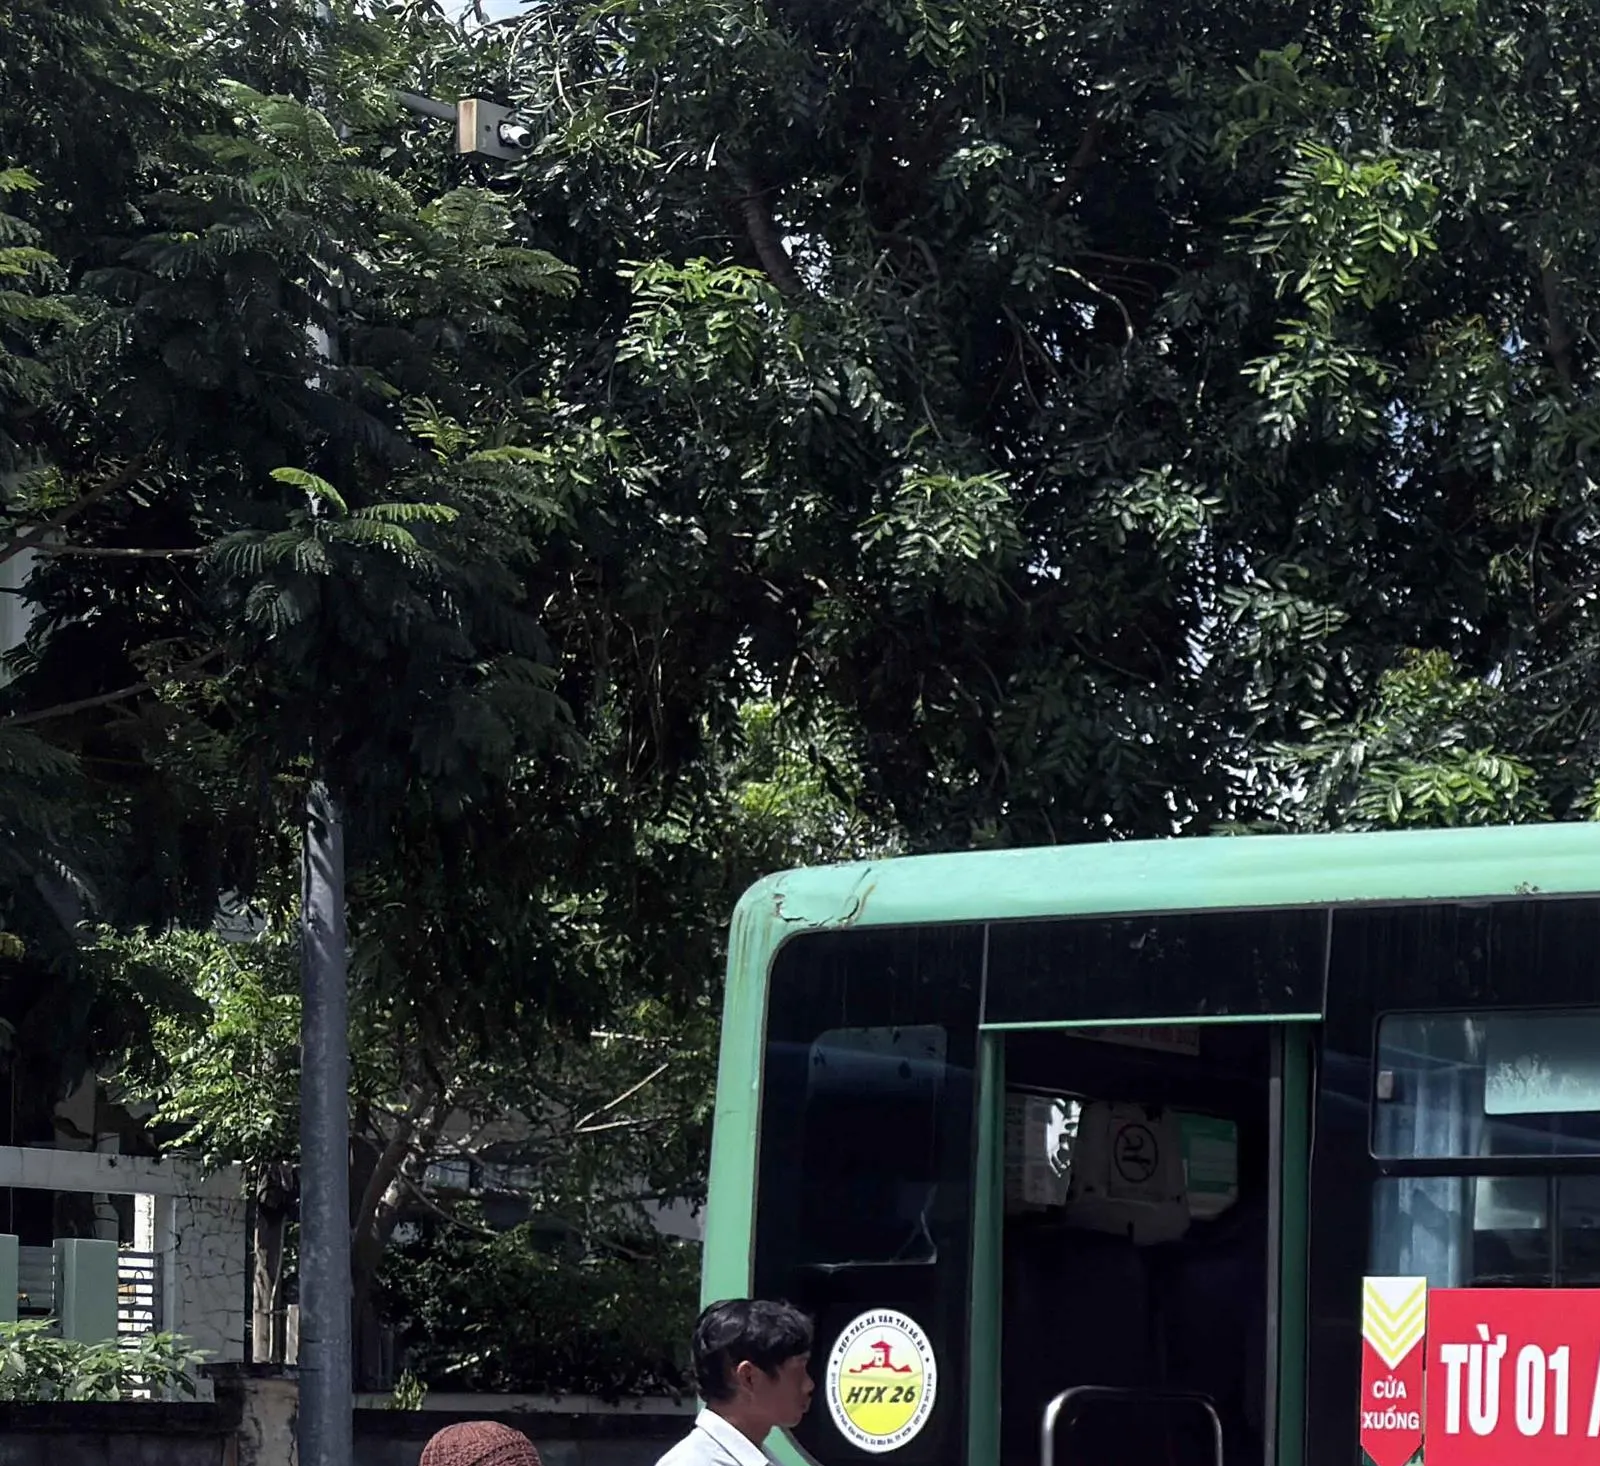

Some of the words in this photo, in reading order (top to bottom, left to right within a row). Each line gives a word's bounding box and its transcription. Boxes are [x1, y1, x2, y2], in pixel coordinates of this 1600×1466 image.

[1373, 1375, 1407, 1399] CỬA
[1440, 1324, 1507, 1436] TỪ
[1516, 1344, 1570, 1436] 01
[846, 1386, 888, 1403] HTX
[889, 1386, 915, 1403] 26
[1363, 1404, 1420, 1430] XUỐNG
